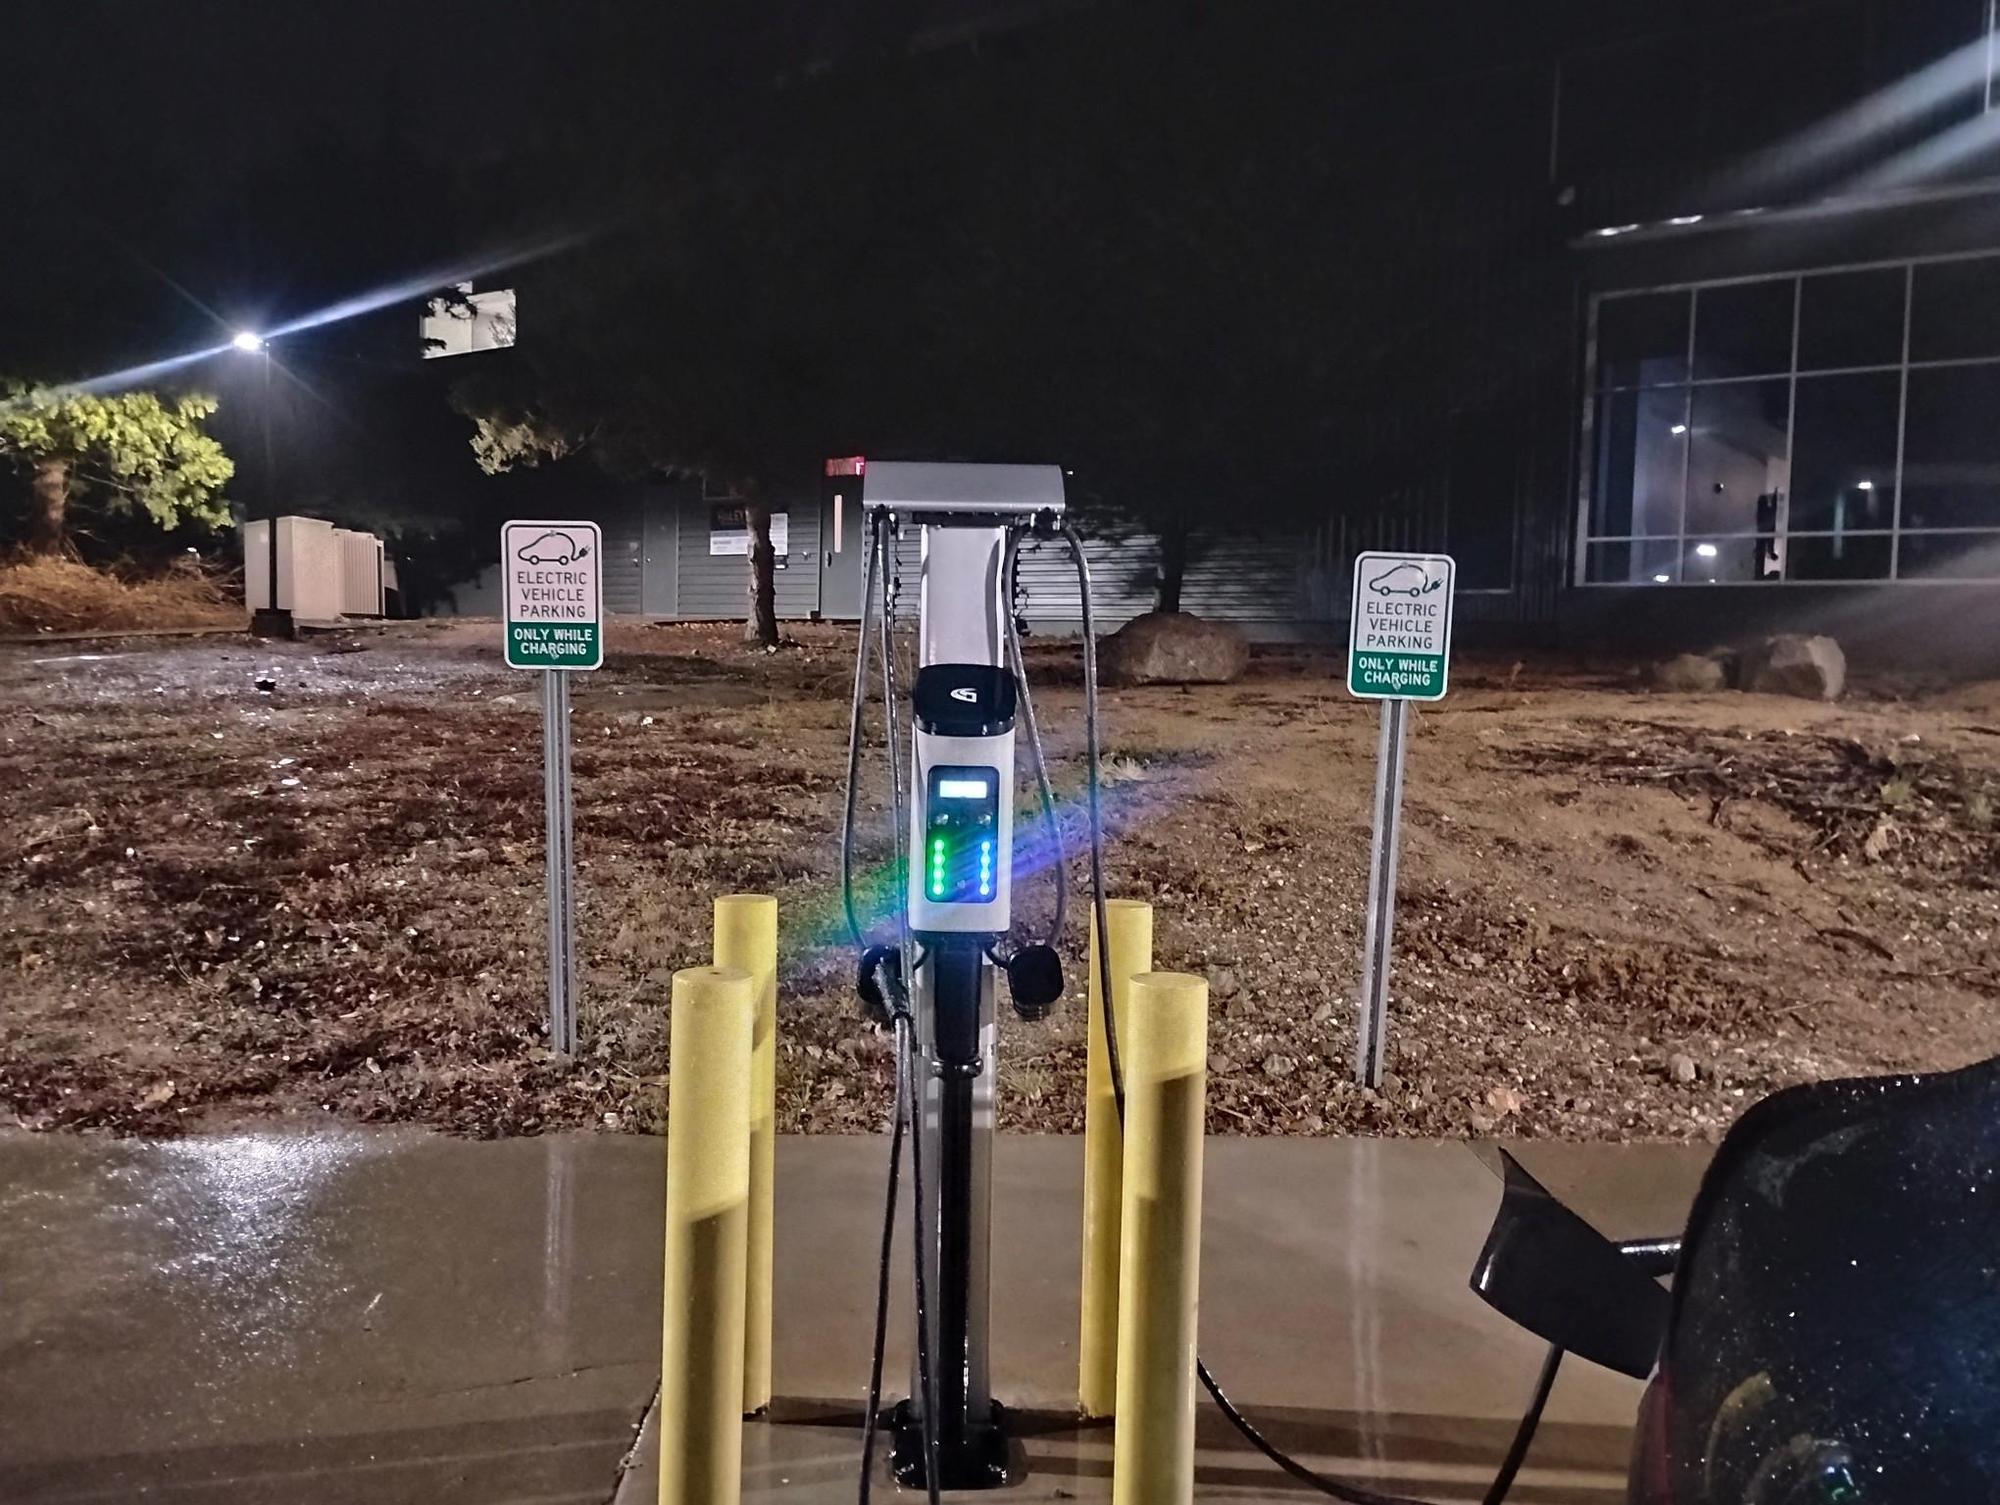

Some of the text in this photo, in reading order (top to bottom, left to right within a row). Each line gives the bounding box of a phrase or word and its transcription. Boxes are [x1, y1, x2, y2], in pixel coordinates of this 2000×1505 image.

[517, 571, 587, 584] ELECTRIC
[521, 588, 584, 601] VEHICLE
[520, 605, 586, 618] PARKING
[1367, 602, 1437, 616] ELECTRIC
[1369, 618, 1433, 633] VEHICLE
[514, 628, 593, 641] ONLY WHILE
[1367, 634, 1432, 649] PARKING
[520, 643, 587, 655] CHARGING
[1359, 657, 1438, 672] ONLY WHILE
[1364, 671, 1431, 686] CHARGING
